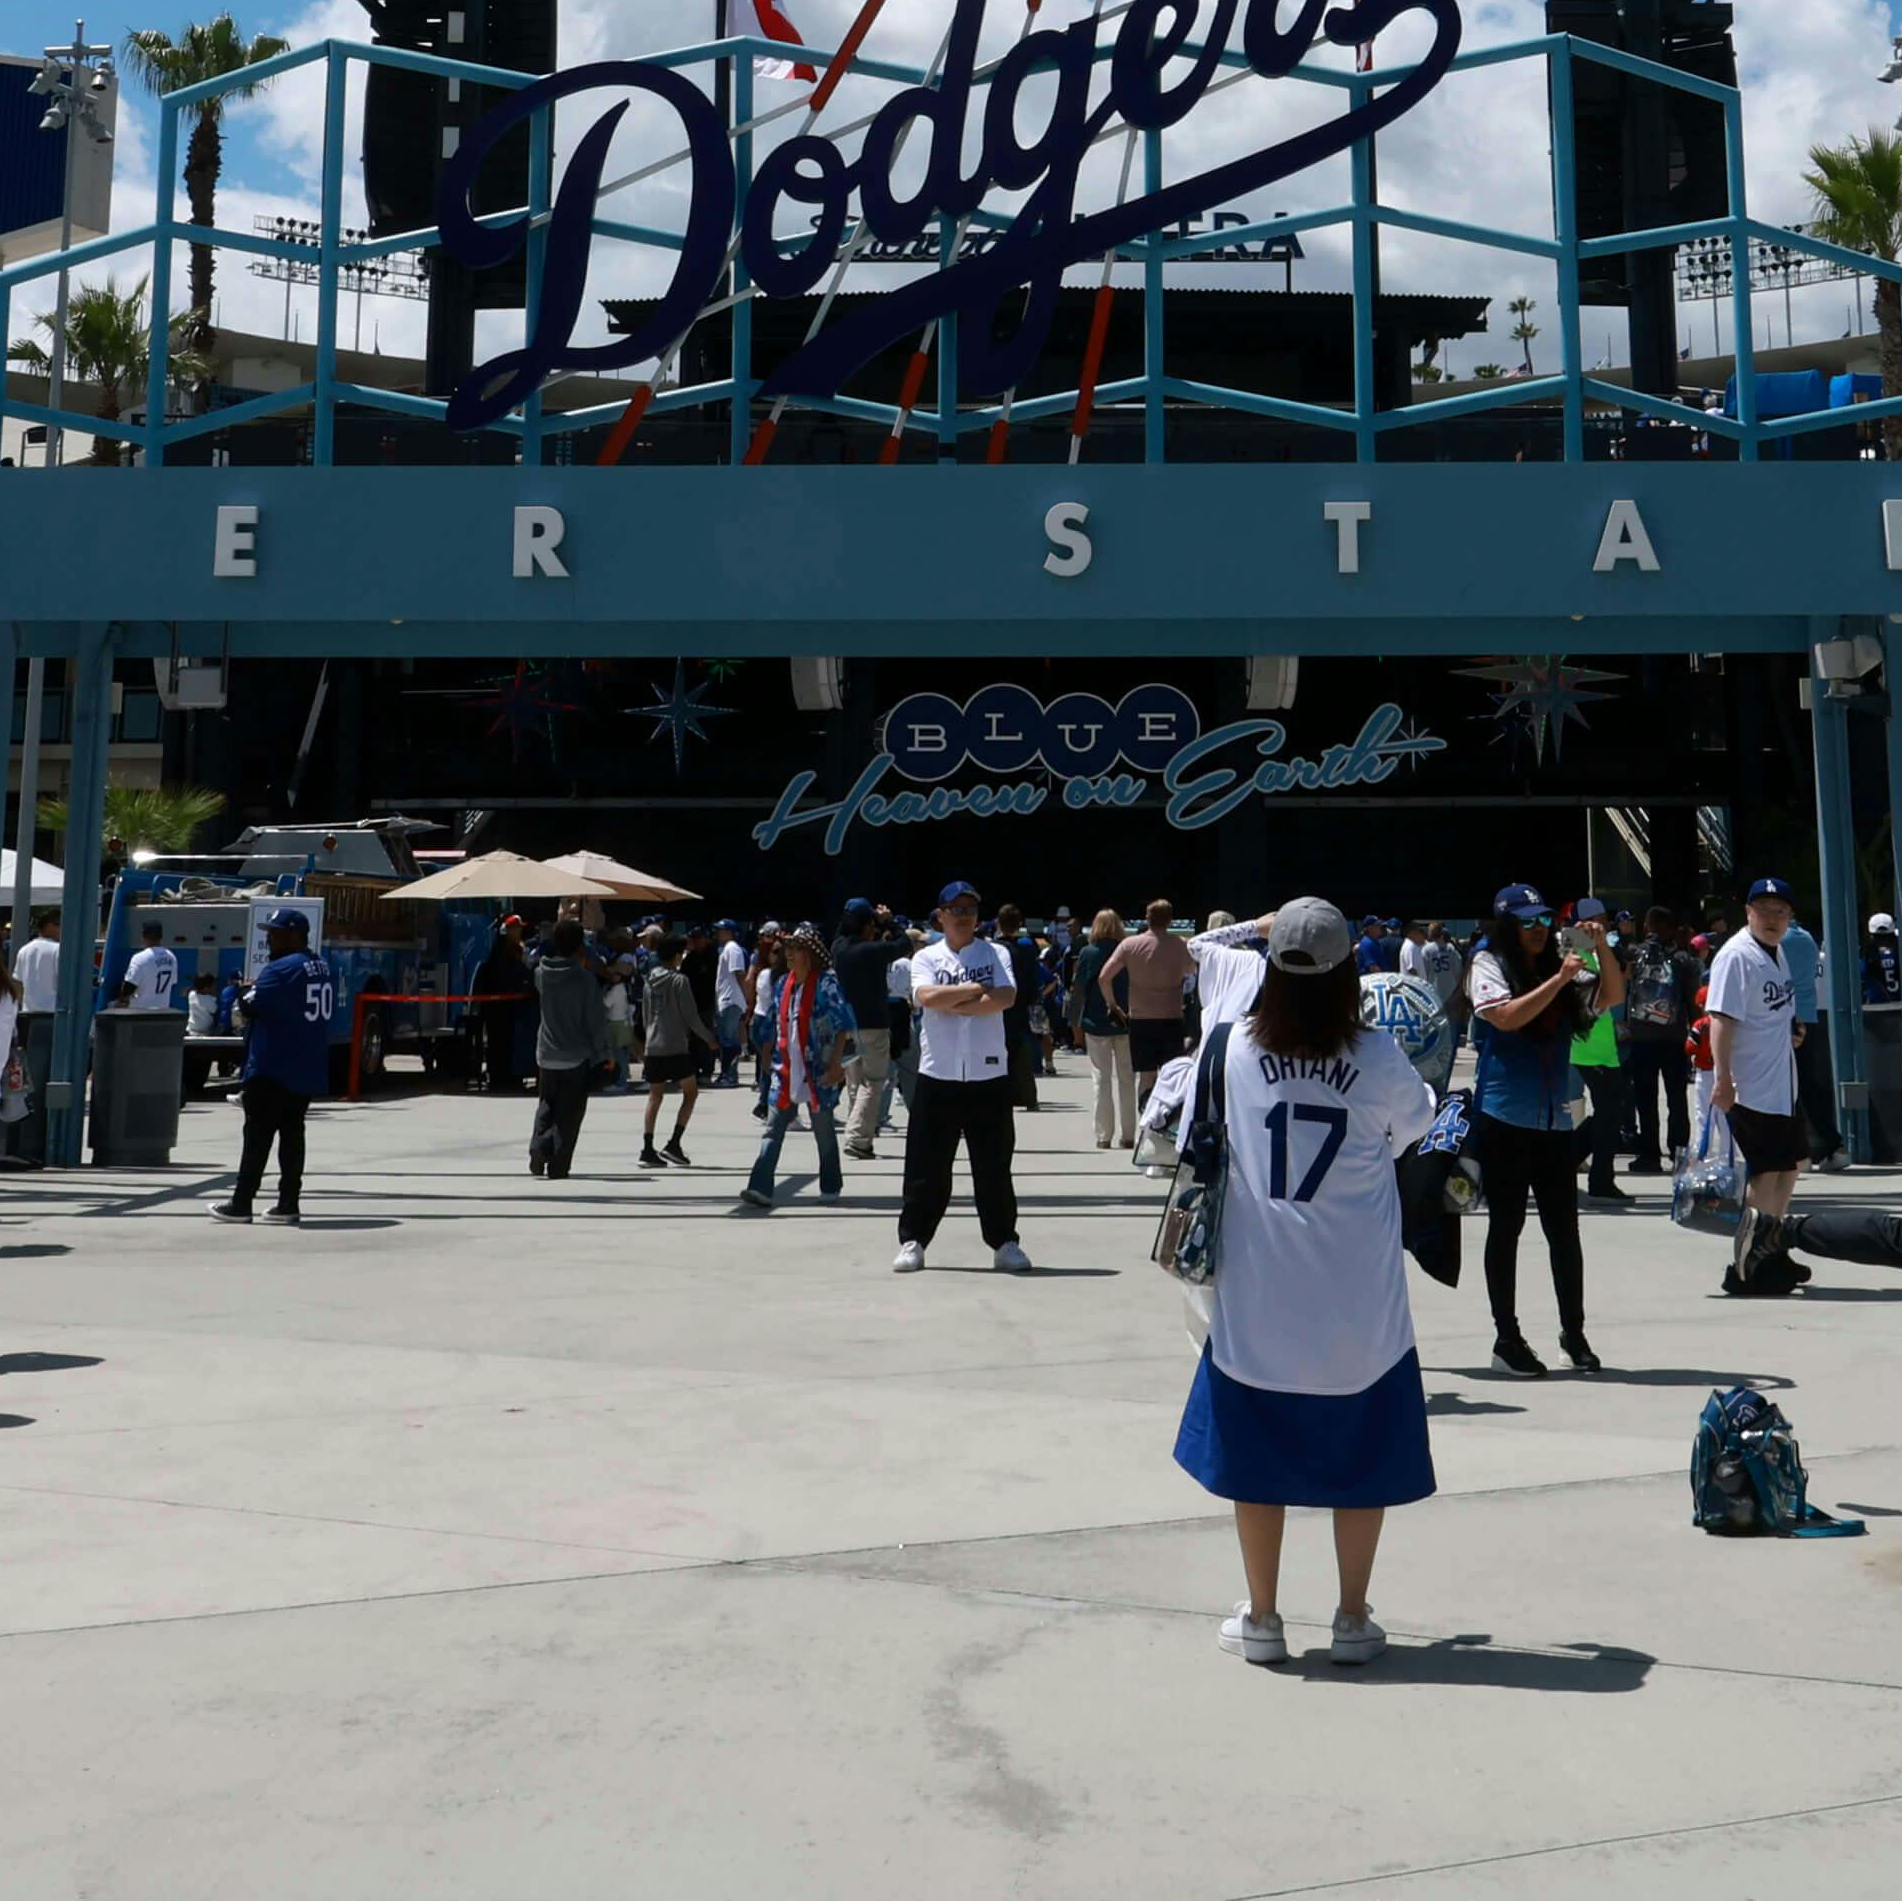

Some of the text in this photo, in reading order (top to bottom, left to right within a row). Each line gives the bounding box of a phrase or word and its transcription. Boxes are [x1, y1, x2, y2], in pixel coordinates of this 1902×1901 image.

[906, 711, 1177, 754] BLUE
[752, 702, 1447, 856] Heaven on Earth
[155, 970, 172, 994] 17
[1432, 956, 1451, 972] 35
[304, 982, 333, 1022] 50
[1371, 983, 1423, 1043] LA
[1259, 1053, 1361, 1095] OHTANI
[1263, 1100, 1349, 1203] 17
